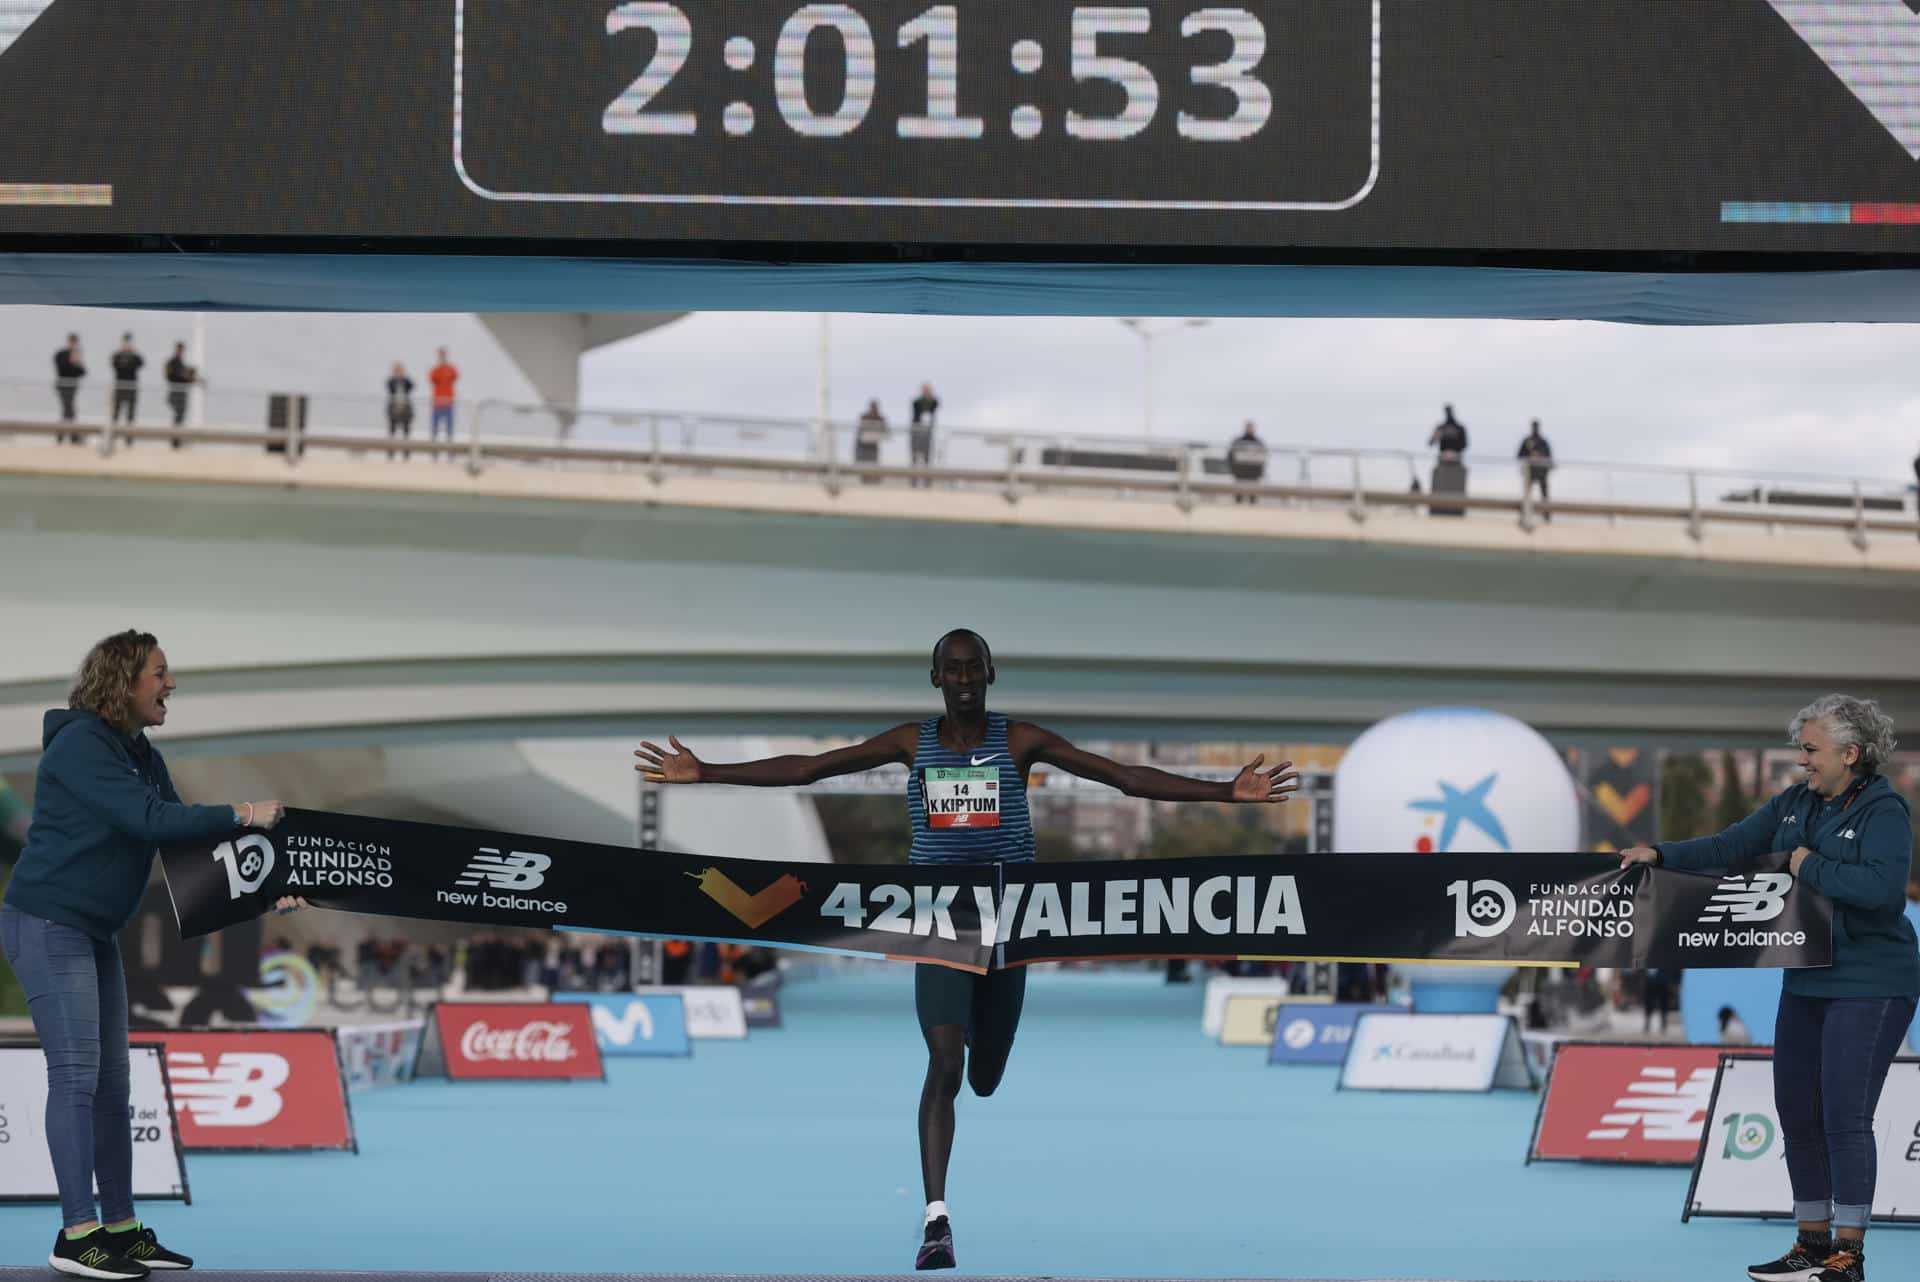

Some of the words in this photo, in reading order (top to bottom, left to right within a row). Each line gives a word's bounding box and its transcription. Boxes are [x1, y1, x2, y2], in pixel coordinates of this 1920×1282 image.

[601, 1, 1274, 141] 2:01:53
[953, 784, 970, 796] 14
[930, 799, 939, 813] K
[941, 798, 997, 813] KIPTUM
[287, 835, 391, 856] FUNDACIÓN
[286, 850, 392, 871] TRINIDAD
[286, 870, 393, 888] ALFONSO
[1530, 881, 1634, 896] FUNDACIÓN
[436, 889, 479, 906] new
[483, 892, 568, 913] balance
[820, 882, 957, 941] 42K
[972, 874, 1307, 947] VALENCIA
[1529, 899, 1634, 919] TRINIDAD
[1527, 919, 1634, 938] ALFONSO
[1678, 931, 1720, 947] new
[1723, 927, 1806, 947] balance
[138, 1109, 157, 1120] del
